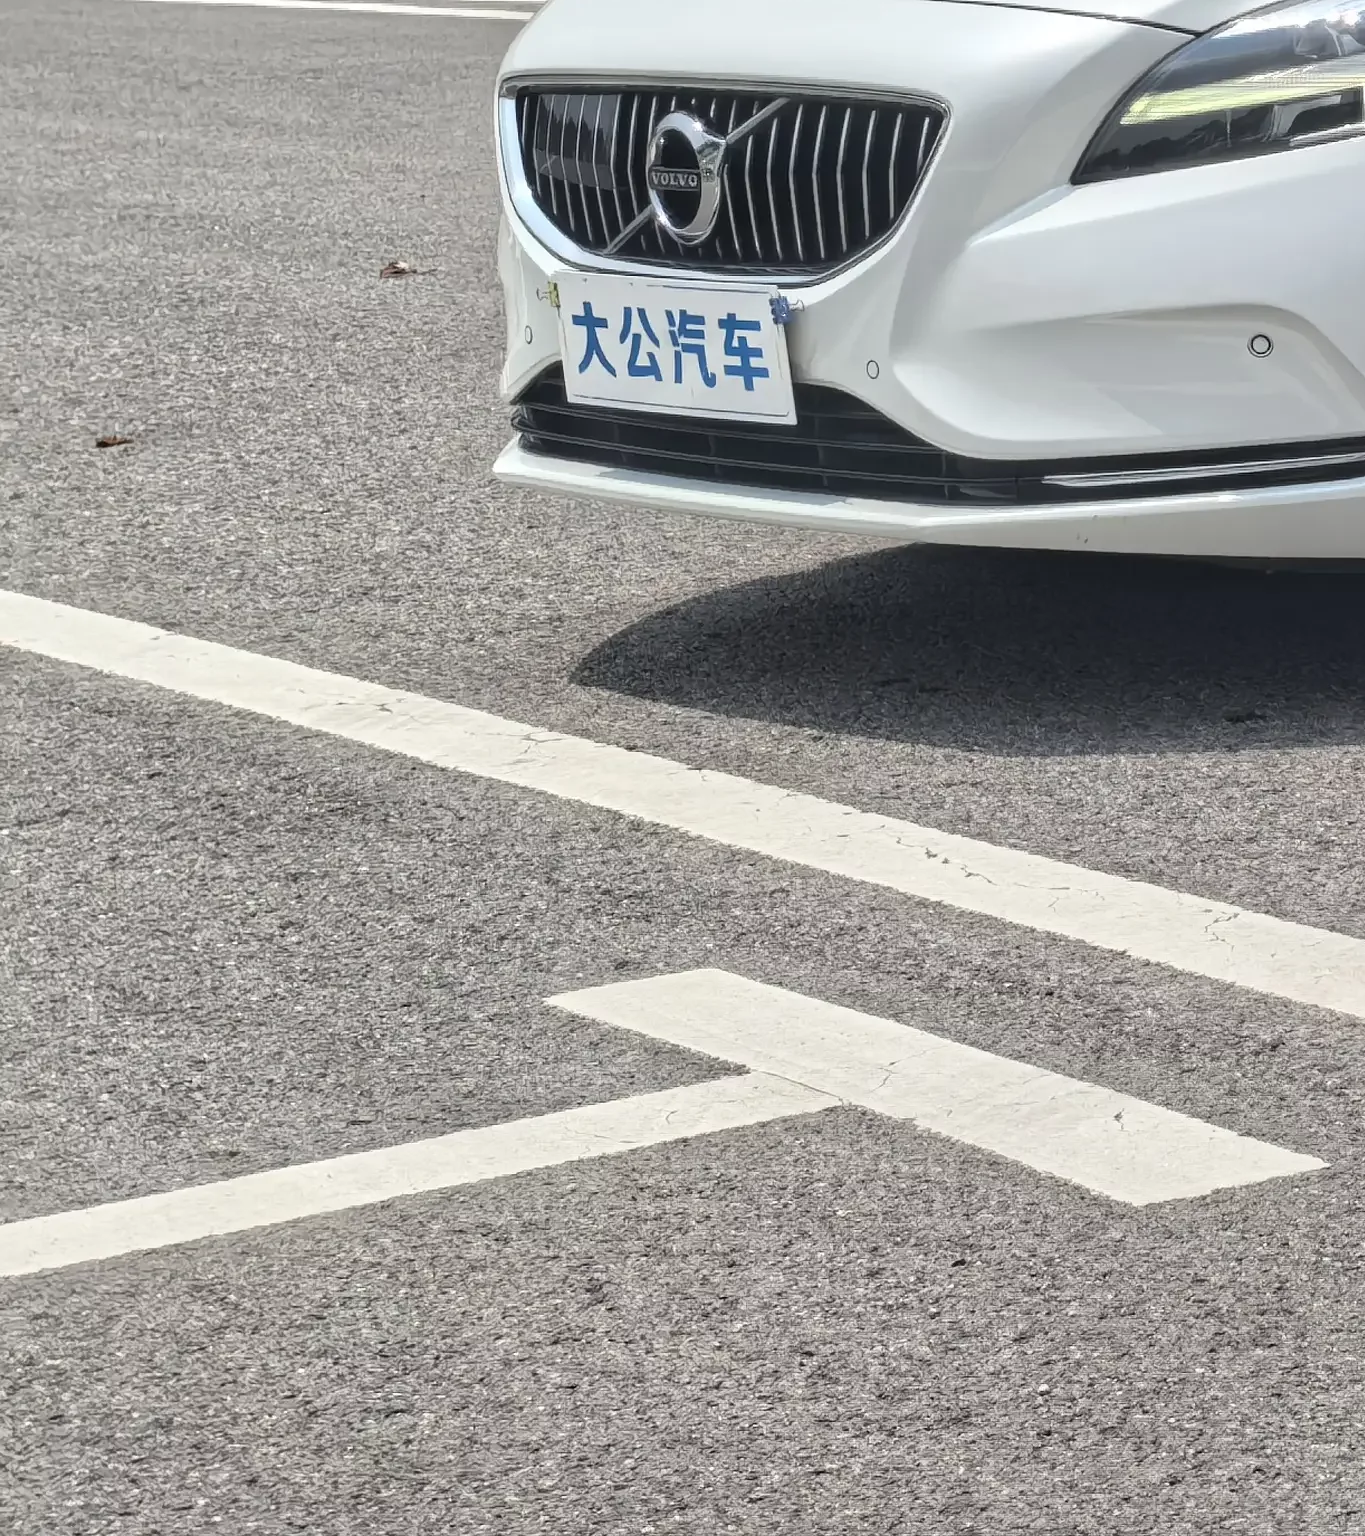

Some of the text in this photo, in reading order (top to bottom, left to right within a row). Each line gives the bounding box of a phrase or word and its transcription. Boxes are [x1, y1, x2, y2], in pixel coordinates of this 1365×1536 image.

[650, 170, 698, 187] VOLVO
[571, 301, 769, 391] 大公汽车
